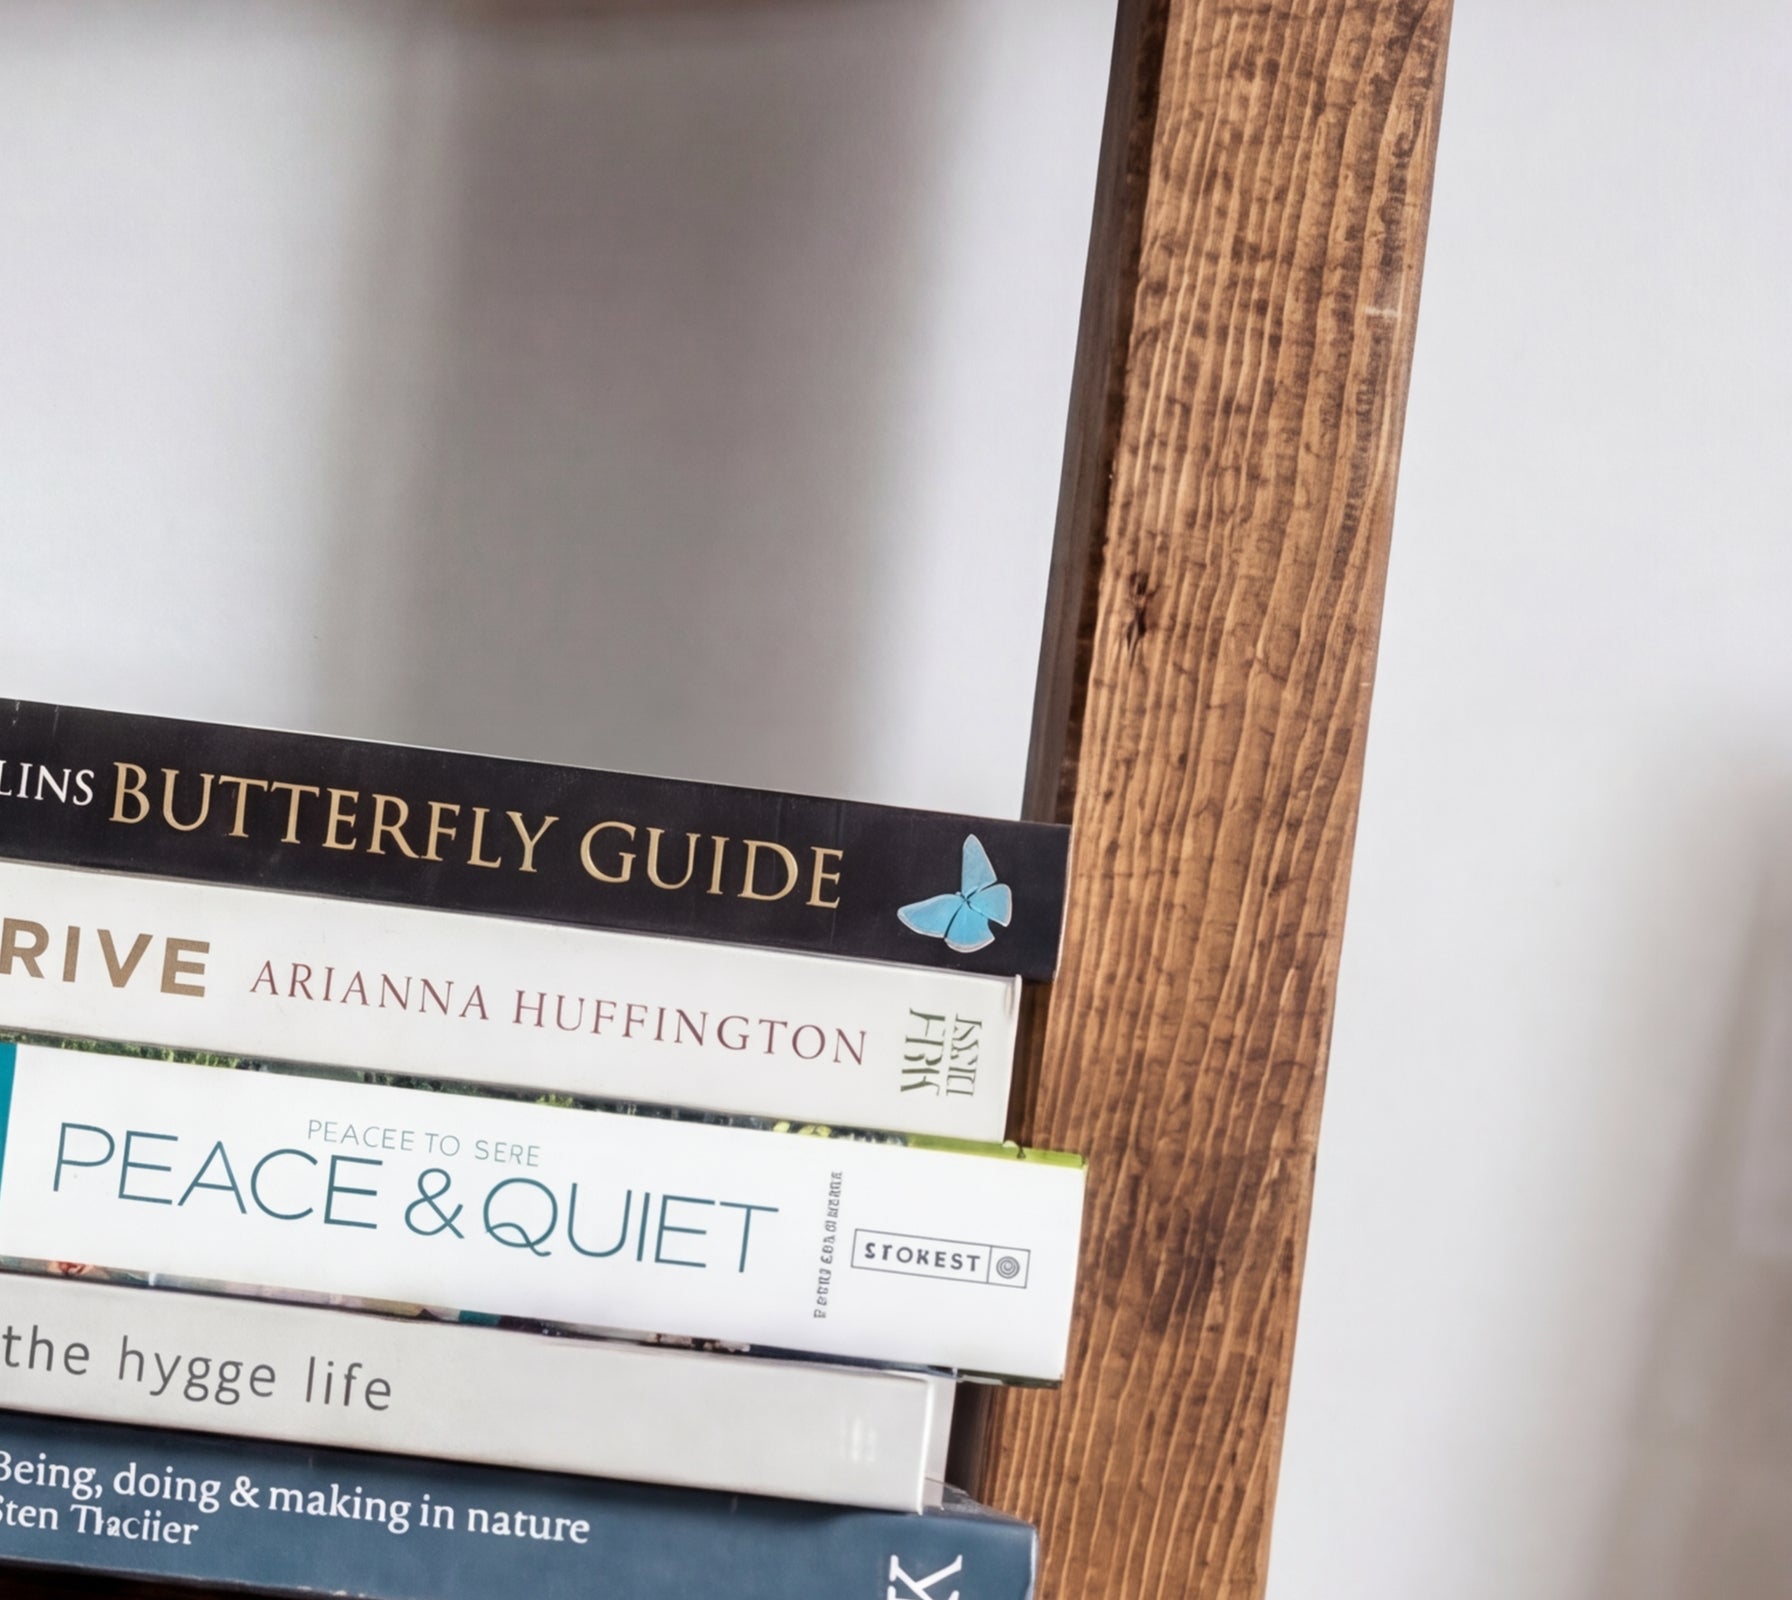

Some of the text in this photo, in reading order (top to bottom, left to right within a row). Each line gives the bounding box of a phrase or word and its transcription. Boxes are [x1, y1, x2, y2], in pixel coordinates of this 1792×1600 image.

[108, 761, 559, 874] BUTTERFLY
[579, 820, 845, 911] GUIDE
[249, 959, 491, 1022] ARIANNA
[512, 989, 868, 1067] HUFFINGTON
[307, 1119, 542, 1168] PEACEE TO SERE
[52, 1122, 384, 1230] PEACE
[403, 1167, 465, 1239] &
[483, 1177, 780, 1273] QUIET
[1, 1324, 394, 1412] the hygge life
[113, 1462, 222, 1513] doing
[229, 1474, 261, 1509] &
[268, 1483, 412, 1534] making
[419, 1495, 456, 1532] in
[467, 1507, 592, 1545] nature
